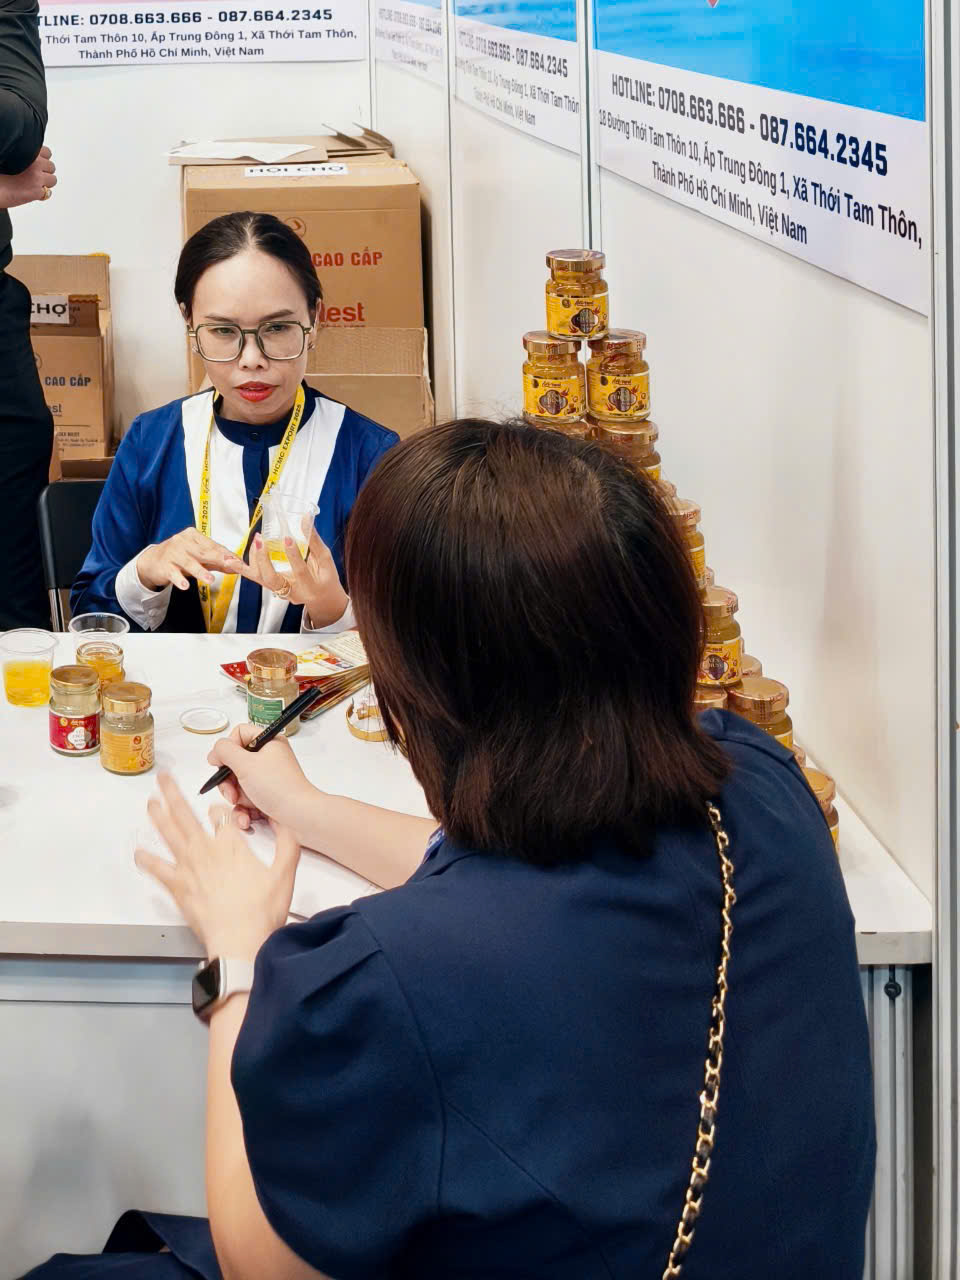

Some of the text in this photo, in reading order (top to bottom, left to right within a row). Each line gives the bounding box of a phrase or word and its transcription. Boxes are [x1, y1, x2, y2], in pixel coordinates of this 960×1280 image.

[89, 12, 202, 25] 0708.663.666
[218, 9, 333, 22] 087.664.2345
[45, 28, 357, 45] Thới Tam Thôn 10, Ấp Trung Đông 1, Xã Thới Tam Thôn,
[79, 45, 264, 59] Thành Phố Hồ Chí Minh, Việt Nam
[516, 48, 568, 78] 087.664.2345
[550, 90, 563, 109] Tam
[611, 73, 656, 108] HOTLINE:
[658, 86, 745, 134] 0708.663.666
[759, 113, 888, 176] 087.664.2345
[649, 126, 665, 148] Tam
[666, 130, 687, 156] Thôn
[689, 140, 701, 165] 10,
[703, 141, 716, 169] Ấp
[718, 149, 746, 184] Trung
[748, 158, 777, 196] Đông
[780, 172, 790, 200] 1,
[793, 174, 808, 203] Xã
[810, 181, 840, 214] Thới
[844, 192, 874, 226] Tam
[878, 203, 922, 249] Thôn,
[652, 160, 807, 245] Thành Phố Hồ Chí Minh, Việt Nam
[312, 246, 383, 267] CAO CẤP
[45, 376, 66, 387] CAO
[273, 404, 302, 476] HCMC EXPORT 2025
